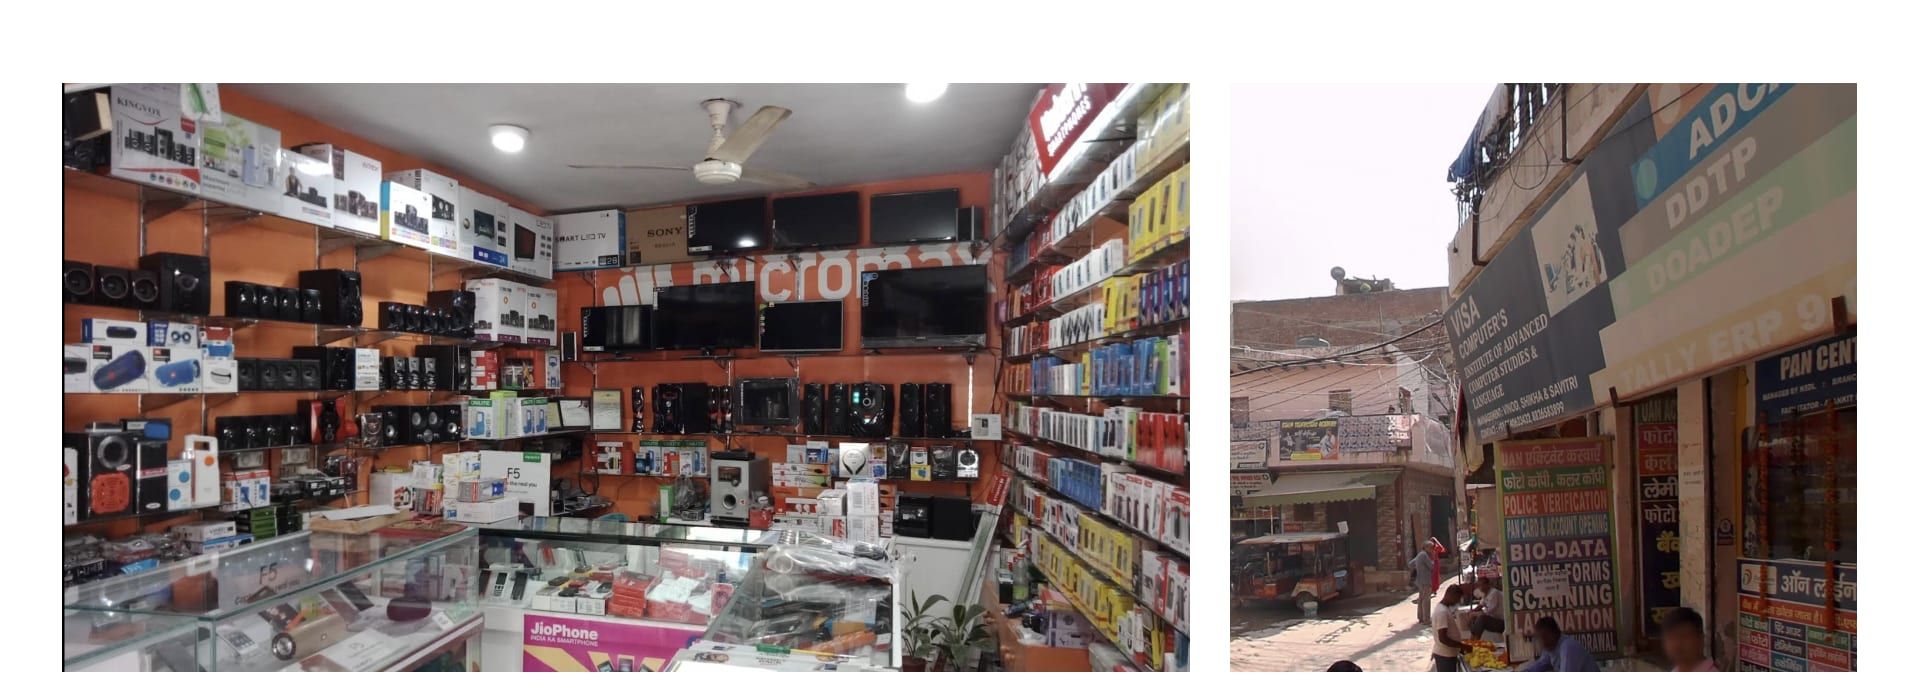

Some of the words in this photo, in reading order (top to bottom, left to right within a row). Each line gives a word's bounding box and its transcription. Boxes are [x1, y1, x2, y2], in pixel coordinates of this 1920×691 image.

[1665, 136, 1757, 230] DDTP
[647, 226, 683, 238] SONY
[1647, 186, 1784, 293] DOADEP
[1451, 295, 1481, 337] VISA
[1458, 308, 1508, 359] COMPUTER'S
[1464, 352, 1495, 377] INSTITUTE
[1493, 343, 1503, 360] OF
[1503, 313, 1548, 353] ADVANCED
[1621, 344, 1698, 391] TALLY
[1708, 309, 1783, 360] ERP
[1799, 293, 1827, 331] 9
[1468, 365, 1499, 394] COMPUTER
[1500, 348, 1531, 376] STUDIES
[1531, 345, 1538, 360] &
[1780, 349, 1812, 381] PAN
[1472, 383, 1505, 410] LANGUAGE
[1543, 385, 1550, 399] &
[1549, 375, 1578, 398] SAVITRI
[507, 467, 521, 479] F5
[1503, 472, 1526, 490] फोटो
[1504, 494, 1538, 516] POLICE
[1541, 489, 1607, 514] VERIFICATION
[1506, 520, 1520, 539] PAN
[1520, 518, 1539, 538] CARD
[1549, 516, 1578, 537] ACCOUNT
[1578, 513, 1609, 535] OPENING
[1510, 539, 1609, 562] BIO-DATA
[1562, 560, 1611, 583] FORMS
[1512, 583, 1613, 611] SCANNING
[1781, 569, 1811, 596] ऑन
[1814, 572, 1857, 602] लईन
[530, 621, 599, 641] JioPhone
[1513, 607, 1615, 634] LANATION
[530, 634, 546, 642] INDIA
[547, 635, 555, 643] KA
[555, 636, 599, 648] SMARTPHONE
